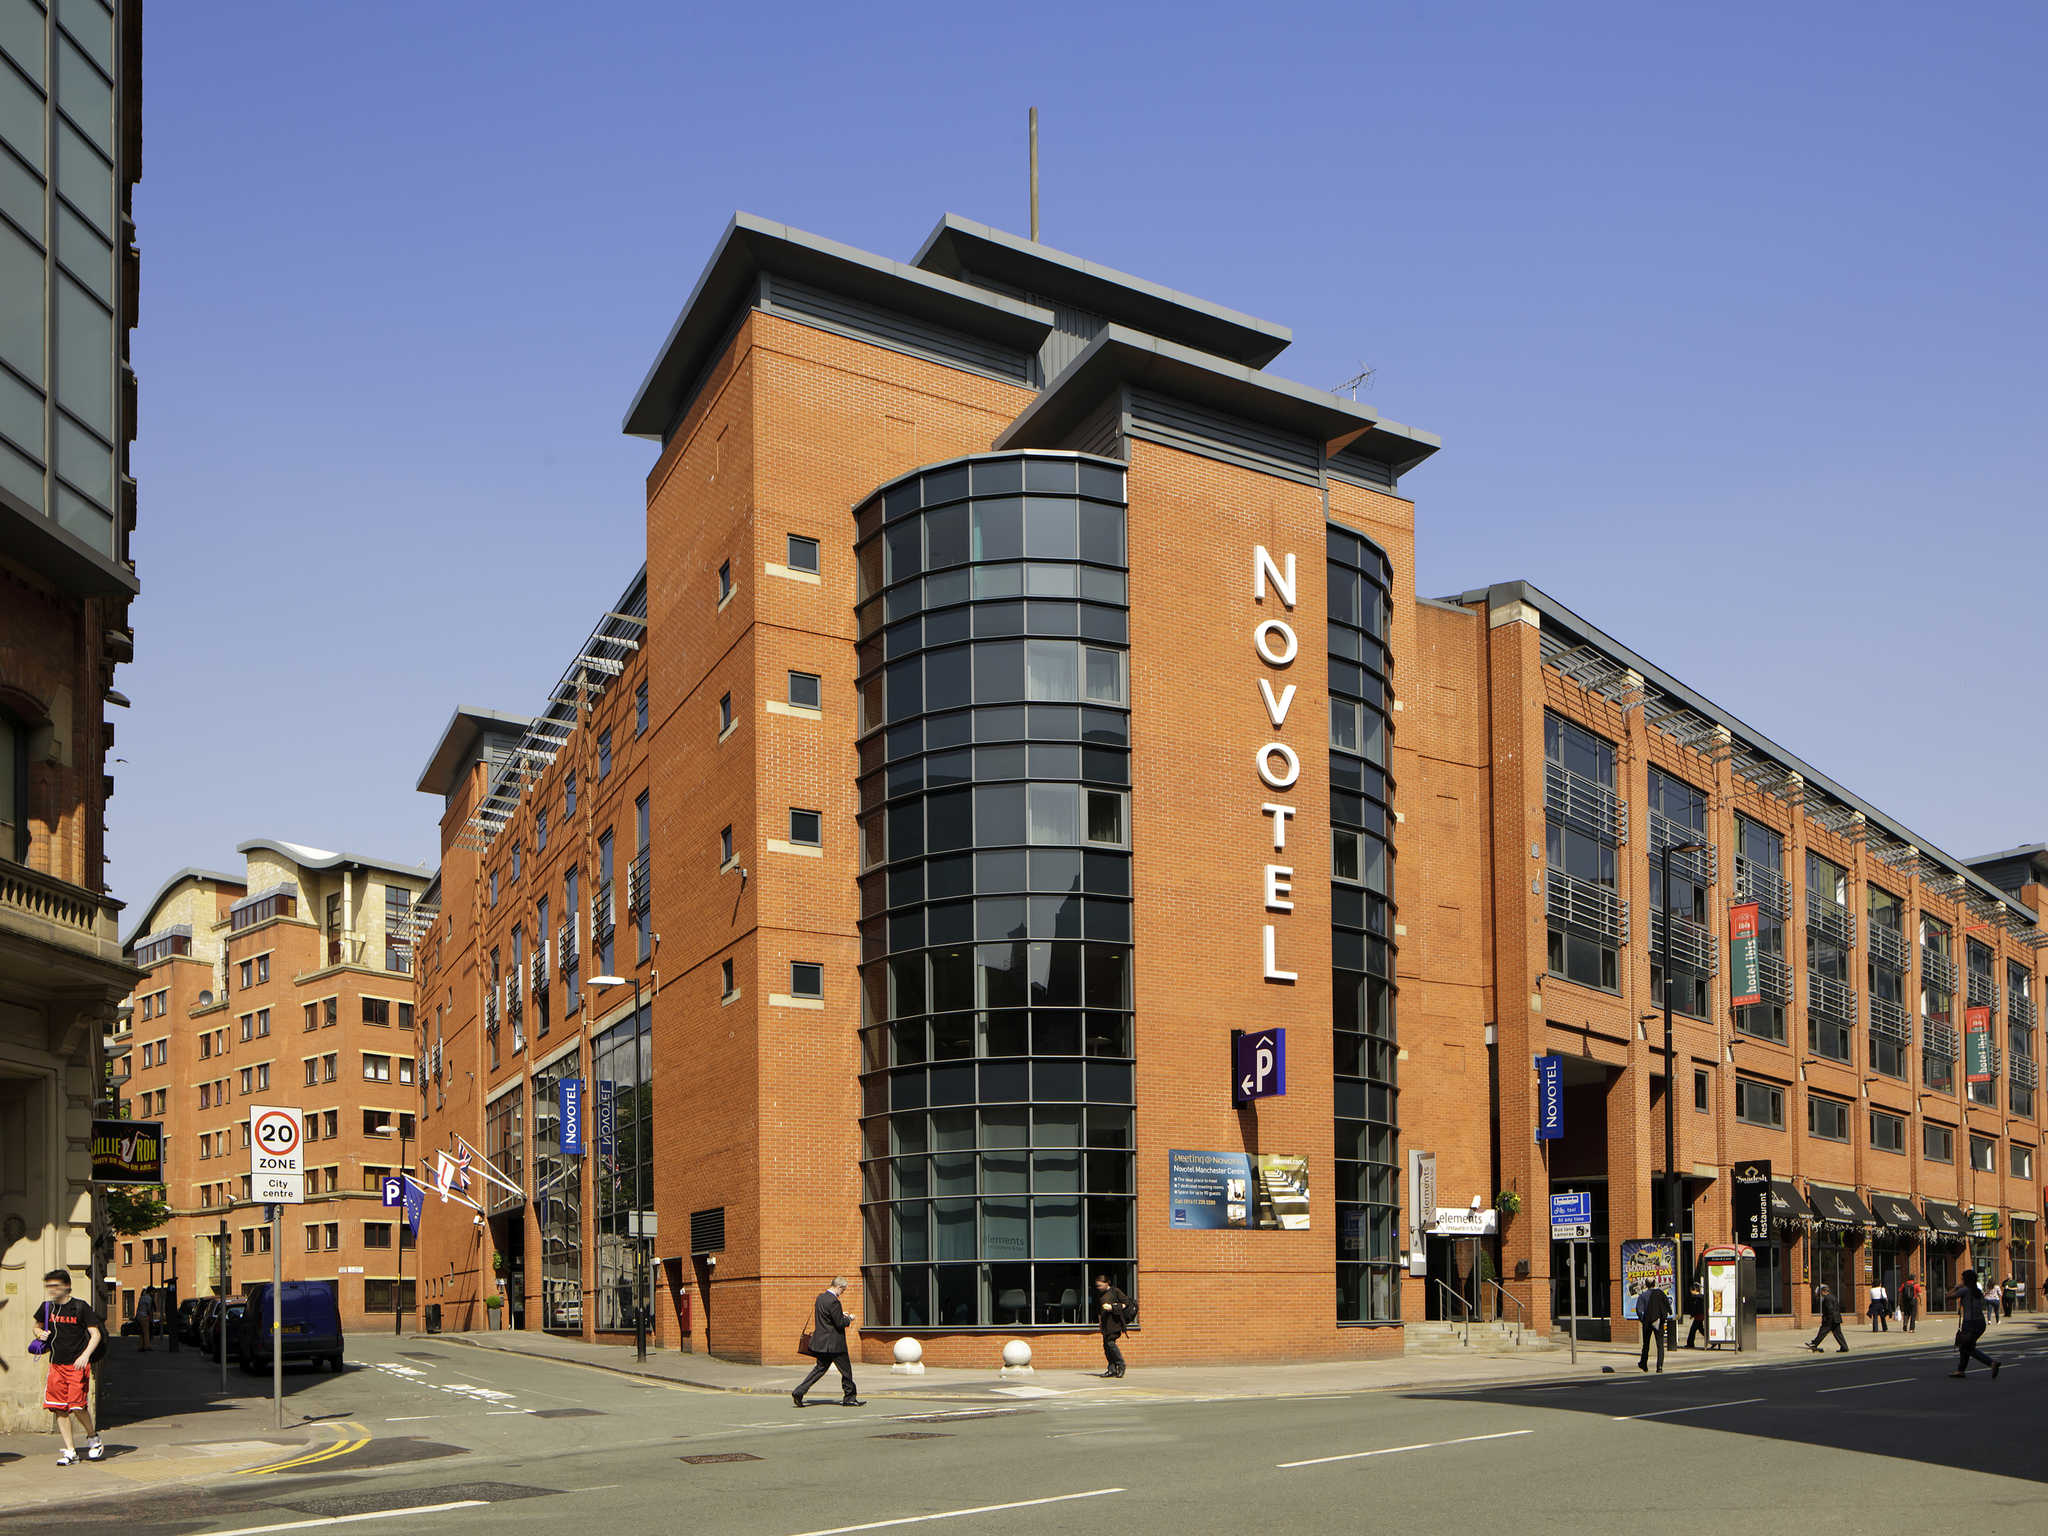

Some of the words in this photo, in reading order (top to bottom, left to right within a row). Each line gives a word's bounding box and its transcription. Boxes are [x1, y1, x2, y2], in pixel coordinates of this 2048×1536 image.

[1254, 544, 1300, 981] NOVOTEL
[1745, 939, 1756, 961] ibis
[1745, 964, 1757, 993] hotel
[1546, 1061, 1557, 1128] NOVOTEL
[565, 1083, 577, 1144] NOVOTEL
[262, 1124, 293, 1143] 20
[260, 1158, 296, 1169] ZONE
[1173, 1165, 1195, 1173] Novotel
[1196, 1166, 1226, 1174] Manchester
[268, 1180, 288, 1189] City
[1439, 1212, 1482, 1224] elements
[1760, 1192, 1768, 1238] Restaurant
[1750, 1225, 1758, 1238] Bar
